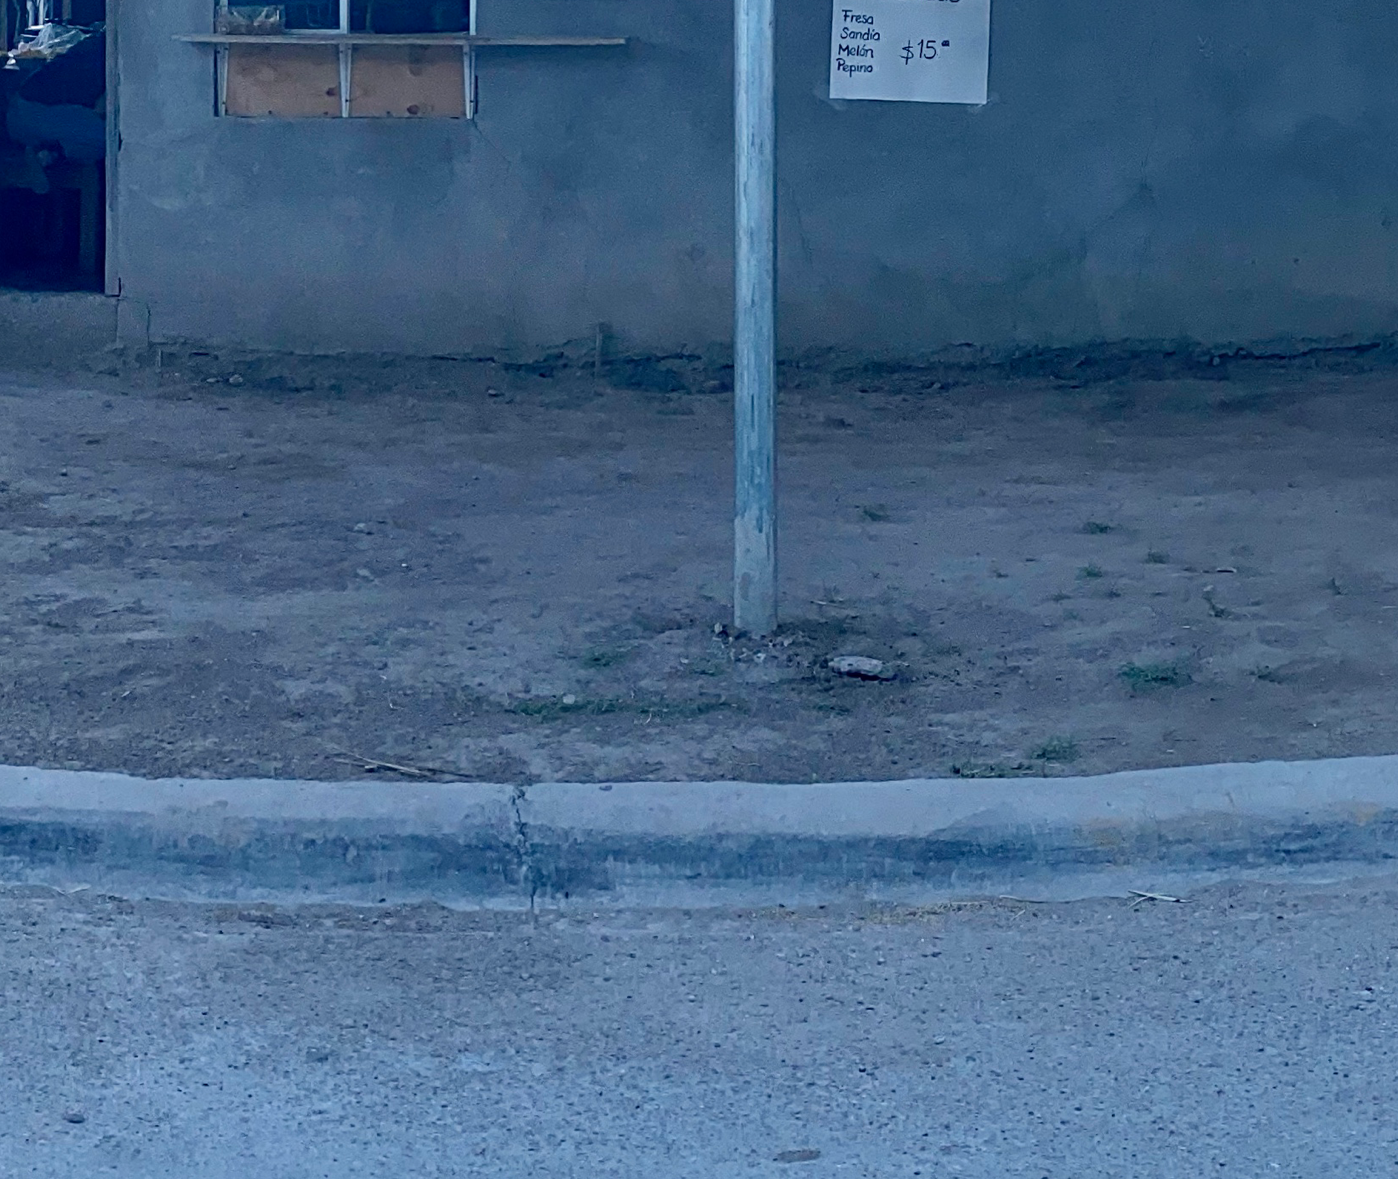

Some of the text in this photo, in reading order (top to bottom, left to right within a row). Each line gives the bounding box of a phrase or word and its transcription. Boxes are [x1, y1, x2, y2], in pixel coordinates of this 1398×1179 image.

[841, 9, 874, 25] Fresa
[837, 43, 875, 59] Melón
[835, 58, 874, 77] Pepino
